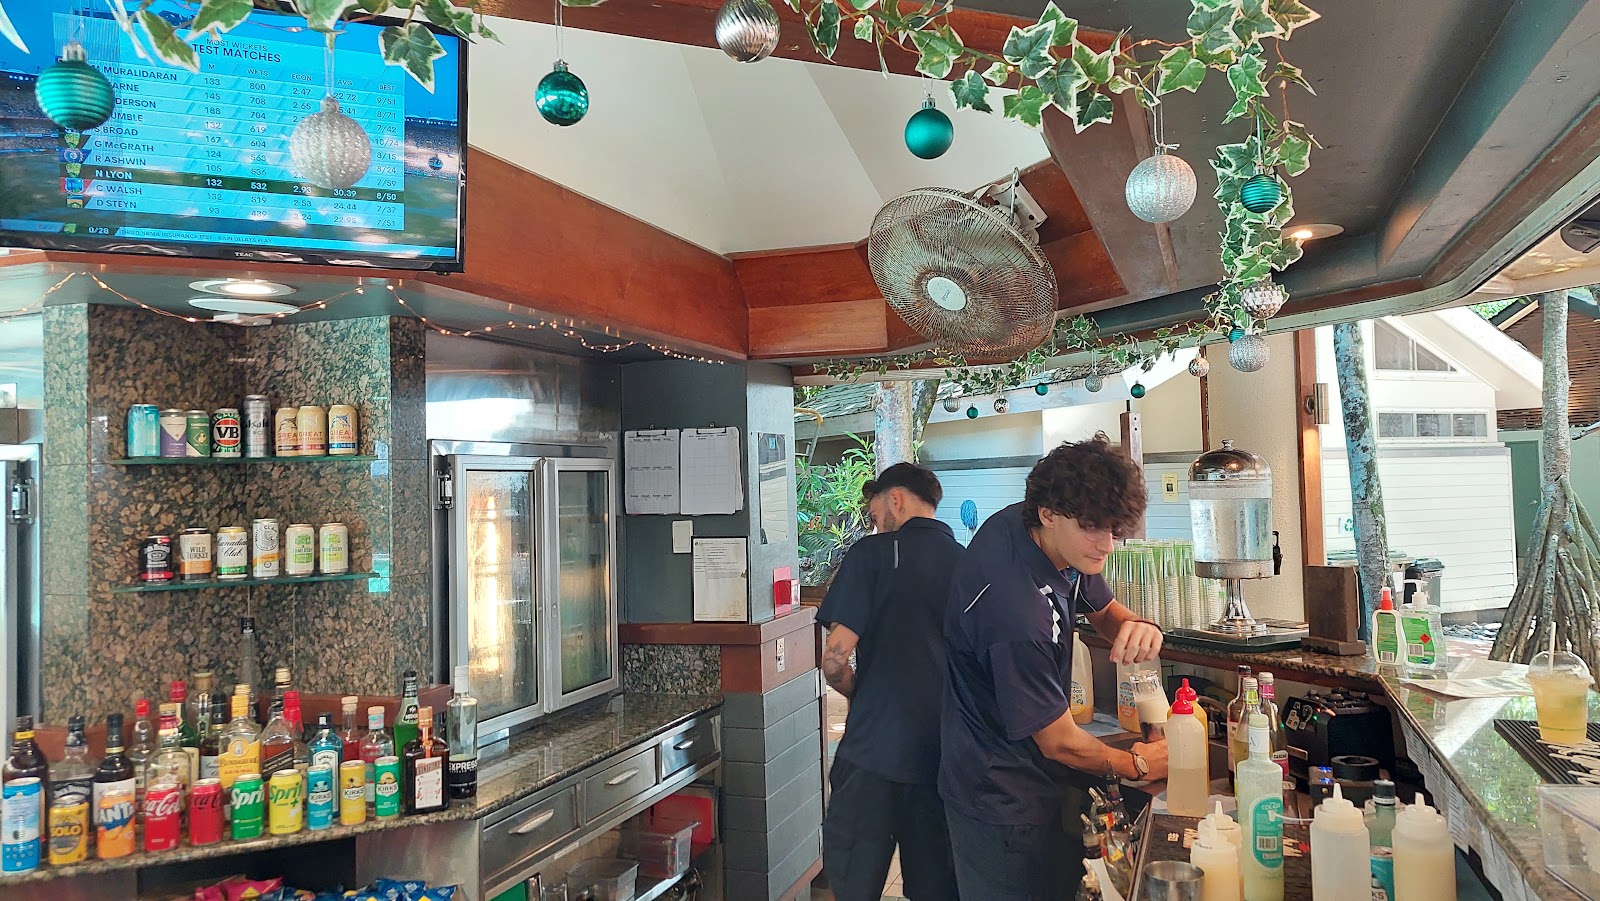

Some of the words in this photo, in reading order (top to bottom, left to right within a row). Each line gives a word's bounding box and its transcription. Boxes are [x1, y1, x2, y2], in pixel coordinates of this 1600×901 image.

[192, 43, 219, 55] TEST
[223, 47, 281, 62] MATCHES
[206, 38, 229, 47] MOST
[231, 42, 268, 52] WICKETS
[247, 68, 268, 76] WKTS
[291, 73, 312, 81] ECON
[104, 66, 177, 81] MURALIDARAN
[204, 78, 220, 86] 133
[250, 82, 266, 90] 800
[292, 88, 311, 96] 2.47
[333, 92, 356, 102] 22.72
[376, 97, 396, 106] 9/51
[110, 82, 140, 92] ARNE
[204, 92, 220, 100] 145
[250, 96, 266, 105] 708
[292, 102, 312, 110] 2.65
[338, 106, 356, 115] 5.41
[376, 110, 396, 120] 8/71
[115, 98, 156, 108] DERSON
[204, 106, 221, 114] 188
[250, 112, 266, 120] 704
[376, 124, 397, 133] 7/42
[110, 112, 143, 122] UMBLE
[205, 122, 222, 130] 132
[250, 126, 266, 134] 619
[374, 138, 399, 148] 10/74
[102, 126, 138, 136] BROAD
[205, 136, 222, 144] 167
[250, 140, 266, 148] 604
[376, 152, 397, 160] 8/15
[94, 140, 102, 148] G
[104, 142, 154, 152] McGRATH
[206, 150, 221, 158] 124
[250, 154, 267, 162] 563
[376, 166, 397, 174] 8/24
[104, 156, 146, 166] ASHWIN
[206, 164, 222, 172] 105
[250, 168, 267, 176] 536
[376, 178, 397, 186] 7/59
[95, 170, 103, 178] N
[105, 170, 133, 180] LYON
[206, 178, 222, 187] 132
[250, 182, 268, 190] 532
[293, 186, 312, 194] 2.93
[334, 188, 357, 198] 30.39
[376, 192, 397, 201] 8/50
[96, 184, 104, 192] C
[106, 186, 142, 195] WALSH
[207, 192, 222, 200] 132
[250, 196, 268, 204] 519
[294, 200, 312, 208] 2.53
[334, 202, 357, 210] 24.44
[376, 206, 397, 214] 7/37
[106, 200, 137, 209] STEYN
[250, 210, 268, 218] 439
[334, 216, 357, 224] 22.95
[376, 218, 396, 226] 7/51
[88, 226, 109, 235] 0/28
[216, 426, 240, 438] VB
[298, 430, 322, 438] GREAT
[330, 428, 354, 436] GREAT
[186, 552, 209, 560] TURKEY
[269, 782, 302, 804] Sprit
[310, 792, 332, 801] KIRKS
[344, 788, 364, 796] KIRKS
[377, 784, 398, 792] KIRKS
